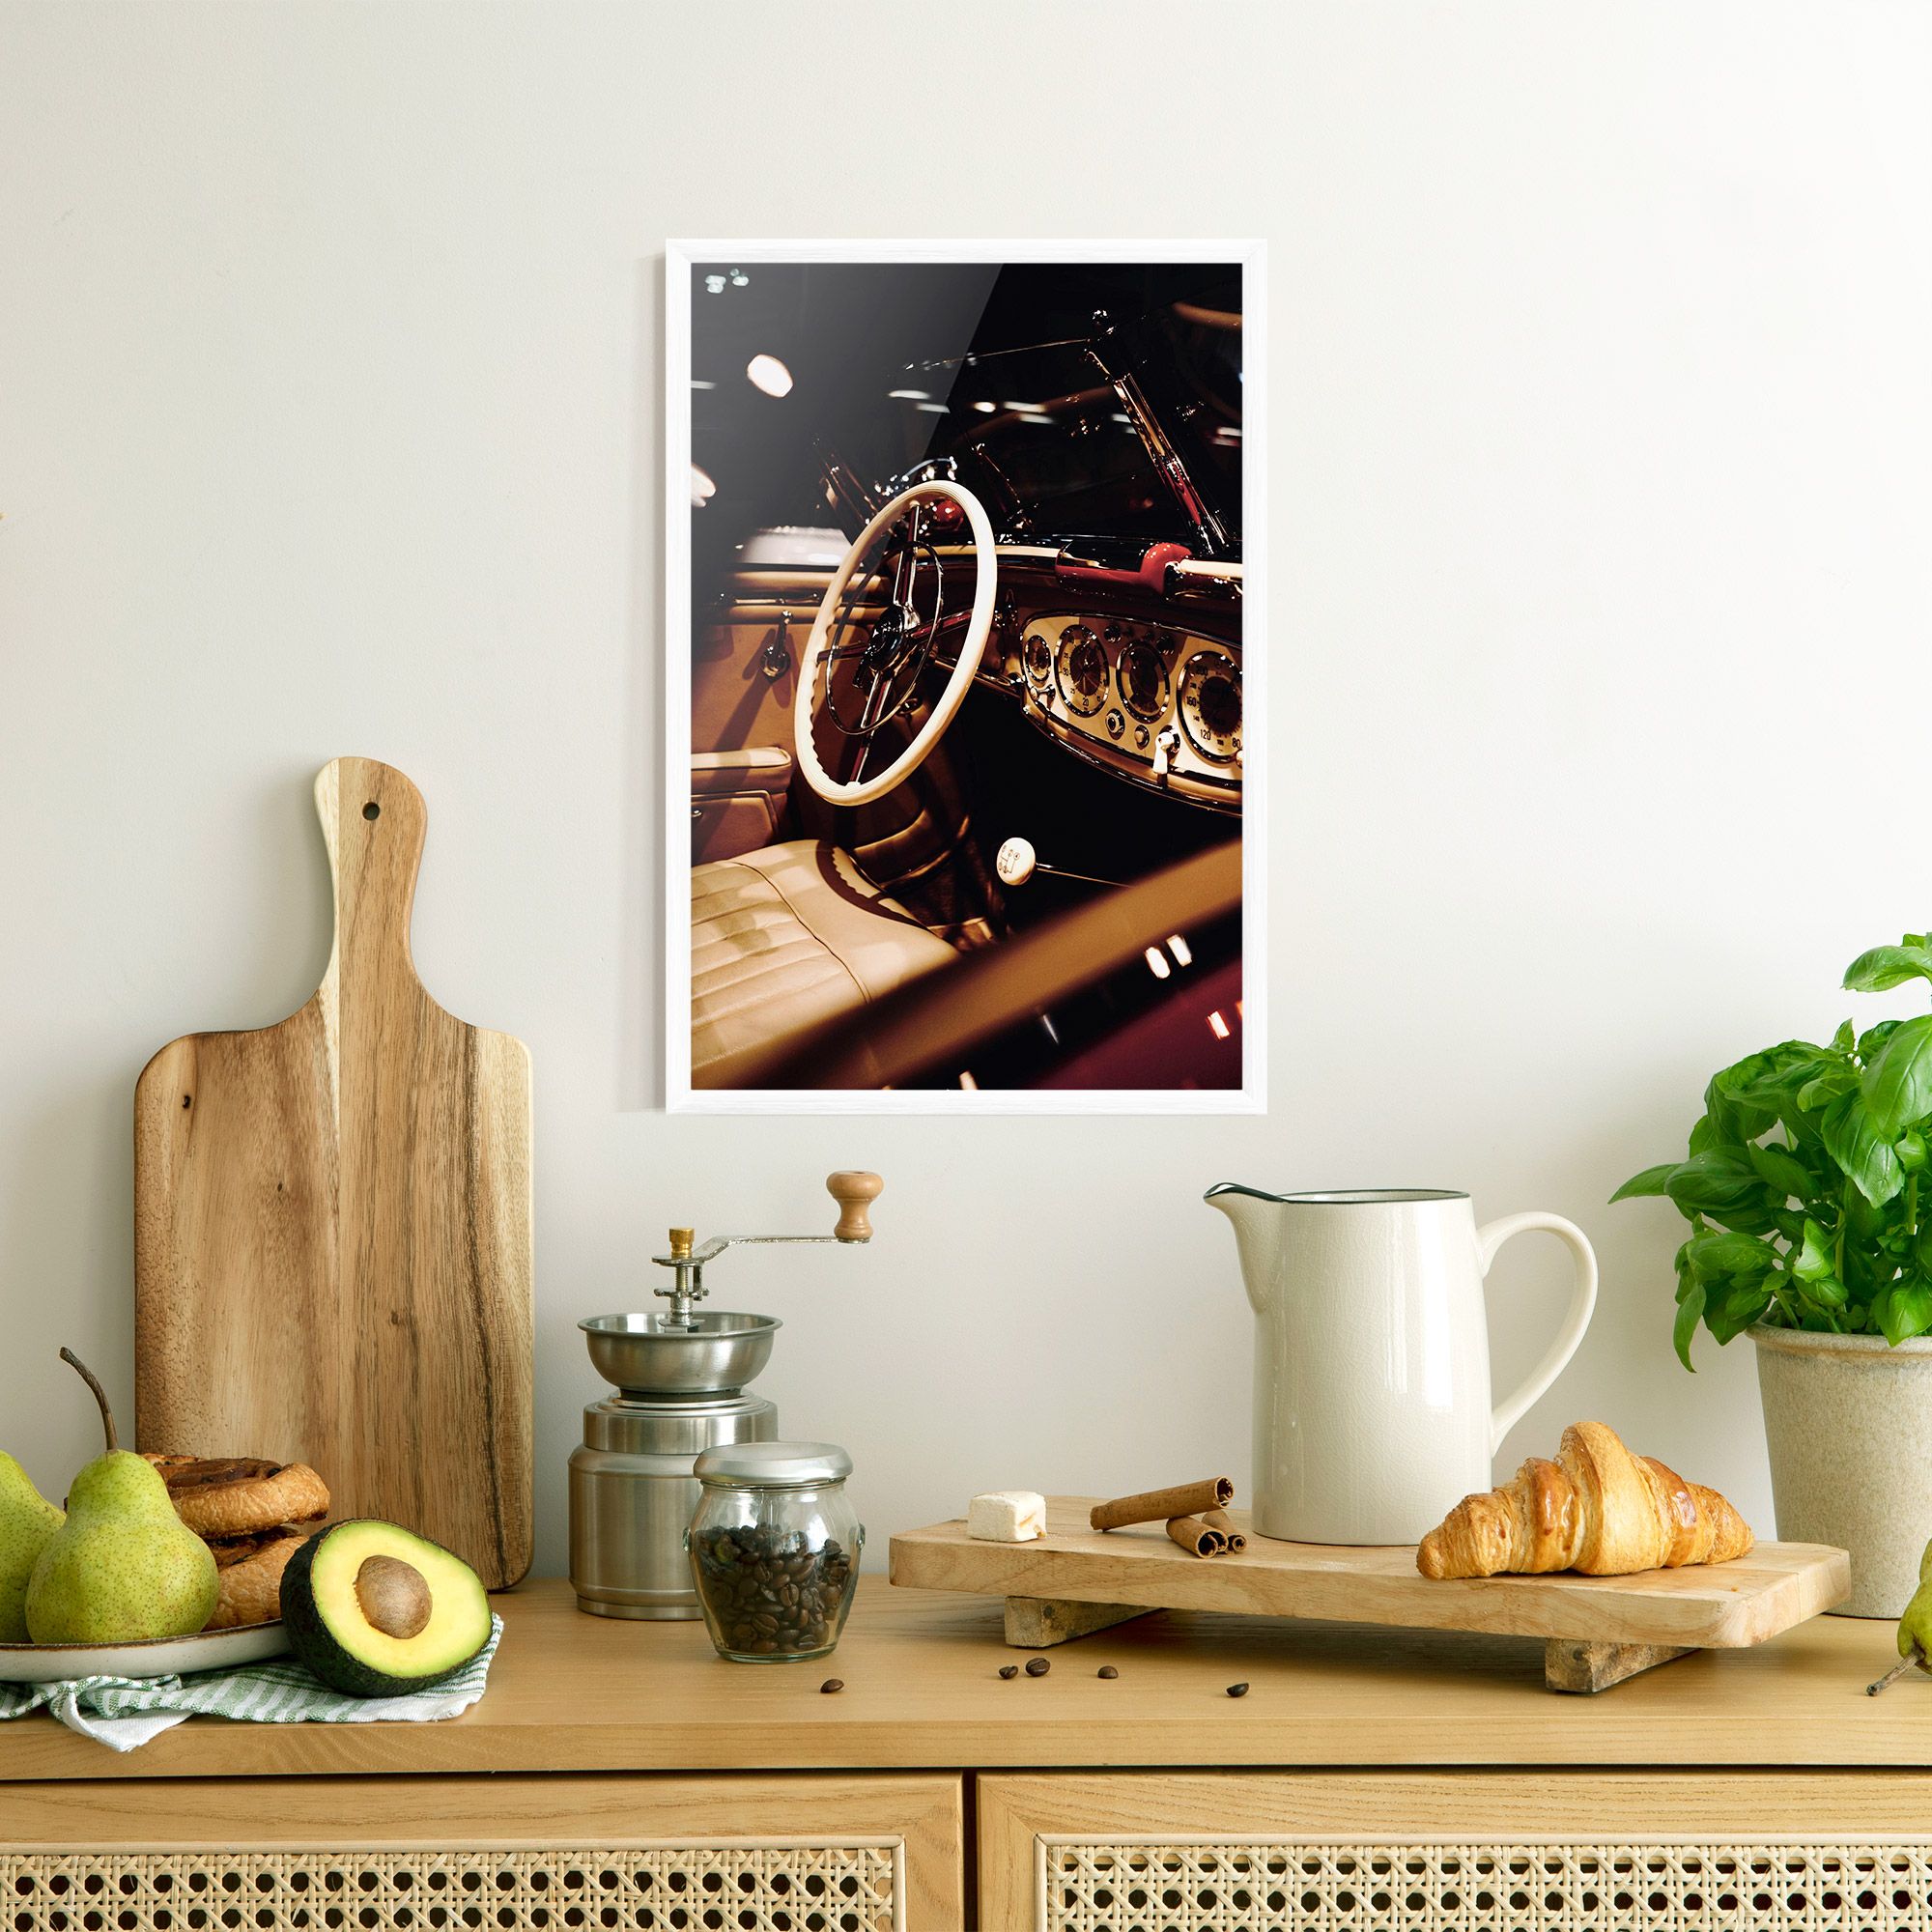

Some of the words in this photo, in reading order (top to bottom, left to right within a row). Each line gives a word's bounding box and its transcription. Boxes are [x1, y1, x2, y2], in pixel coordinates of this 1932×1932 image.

[1082, 697, 1089, 706] 20
[1201, 728, 1211, 741] 120
[1232, 737, 1241, 750] 80
